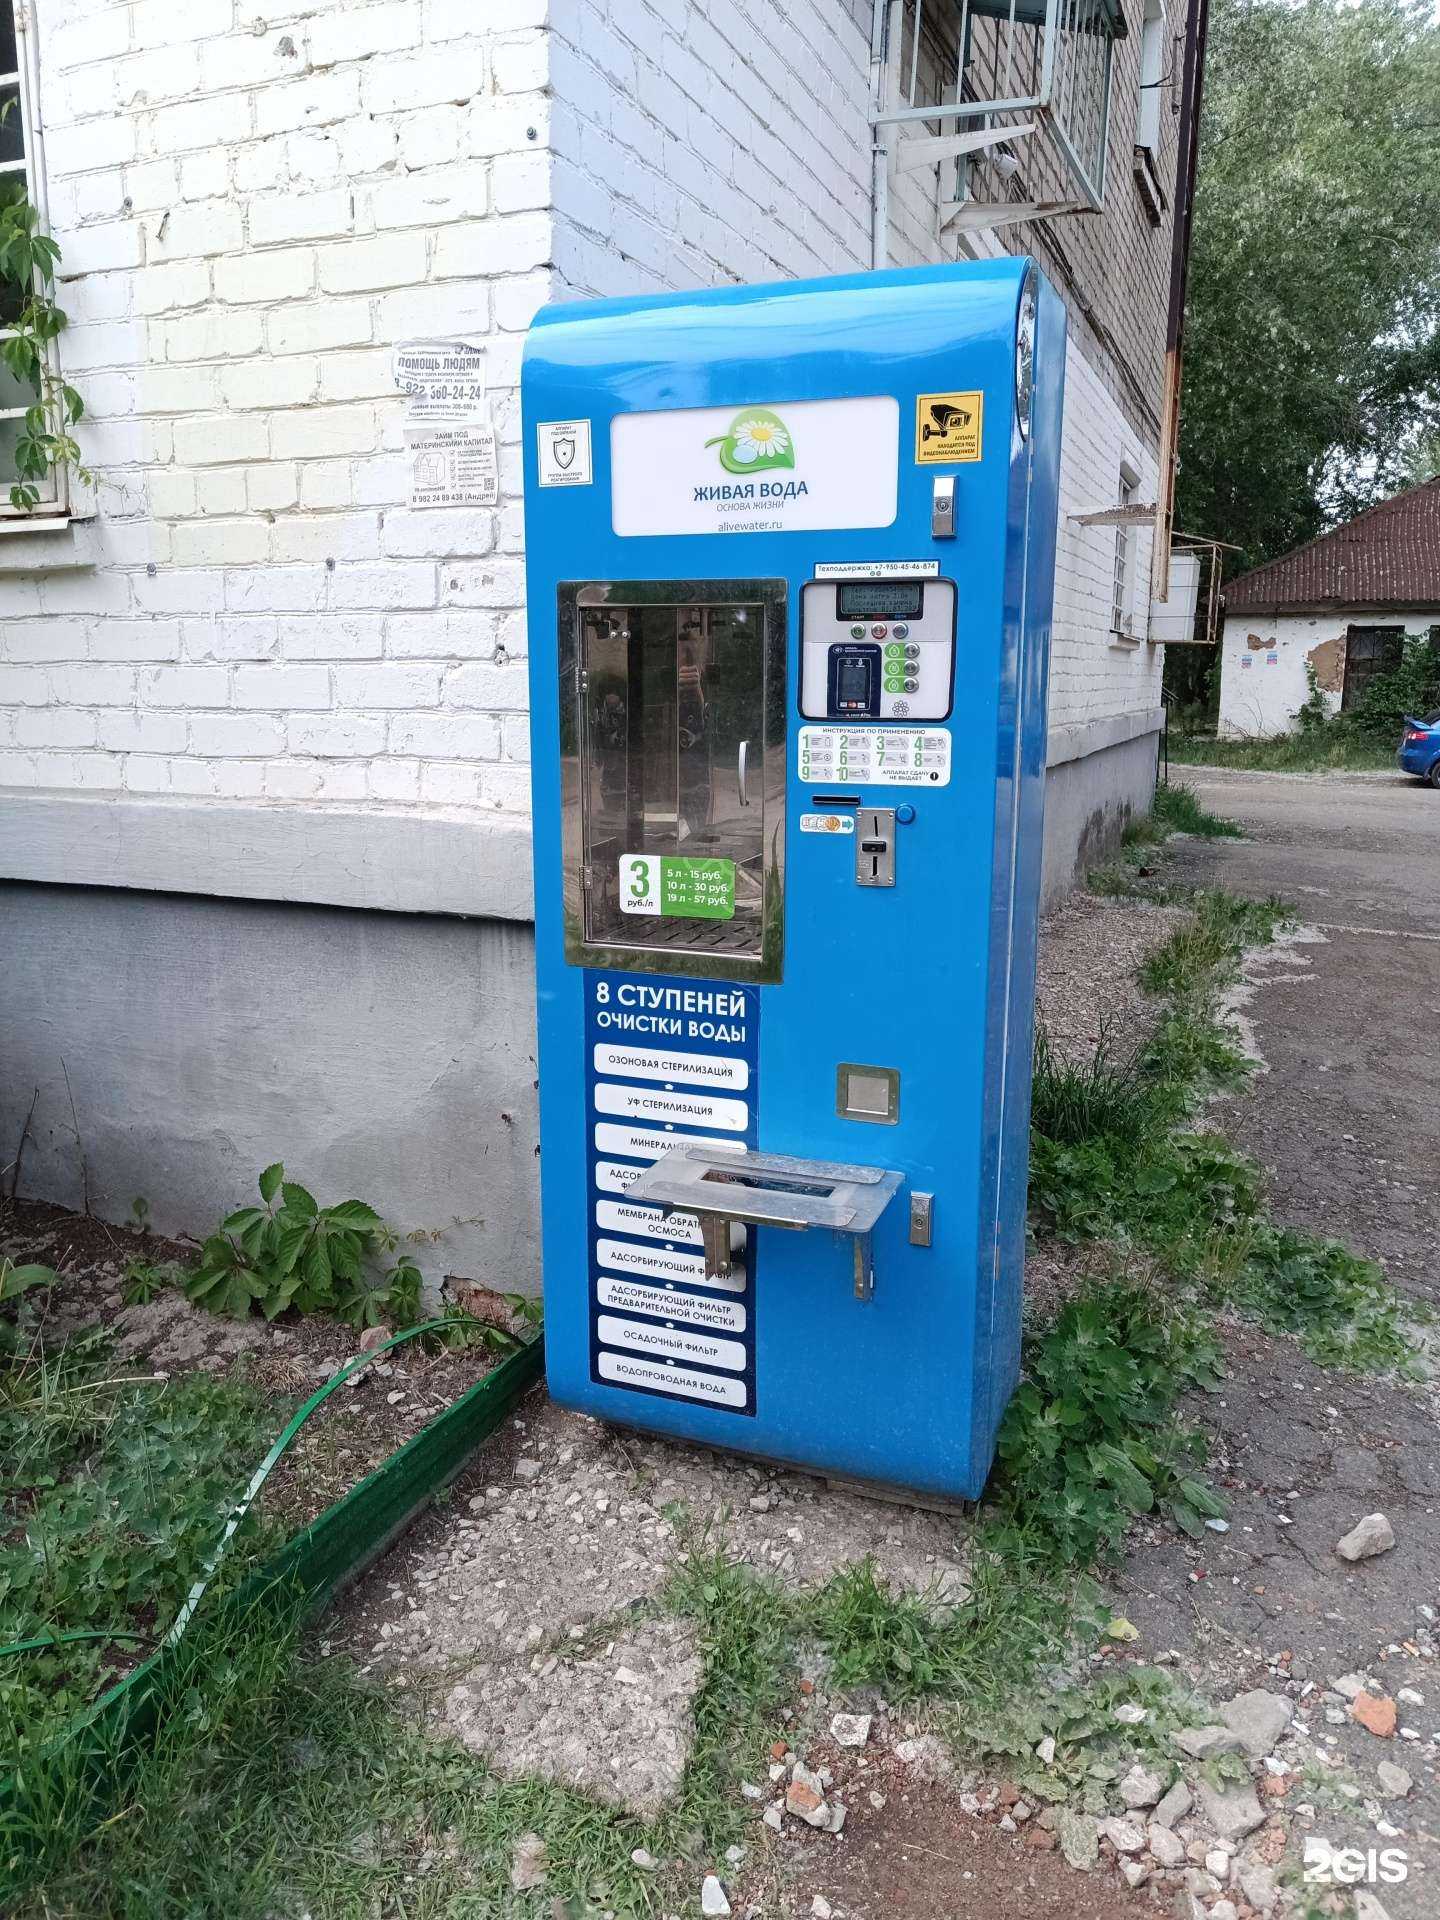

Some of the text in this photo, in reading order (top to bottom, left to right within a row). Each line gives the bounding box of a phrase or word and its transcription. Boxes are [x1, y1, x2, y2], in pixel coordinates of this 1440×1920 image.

[398, 357, 480, 371] ПОМОЩЬ ЛЮДЯМ
[463, 438, 493, 446] КАПИТАЛ
[693, 481, 808, 501] ЖИВАЯ ВОДА
[716, 500, 784, 512] ОСНОВА ЖИЗНИ
[718, 520, 783, 532] alivewater.ru
[818, 565, 872, 573] Техподдержка:
[802, 734, 809, 749] 1
[839, 735, 848, 749] 2
[876, 735, 885, 750] 3
[914, 736, 923, 751] 4
[802, 750, 810, 764] 5
[839, 751, 848, 765] 6
[876, 752, 885, 766] 7
[914, 753, 923, 767] 8
[801, 766, 810, 780] 9
[836, 767, 848, 781] 10
[630, 860, 650, 898] 3
[667, 869, 674, 877] 5
[690, 870, 700, 879] 15
[701, 870, 723, 882] руб.
[667, 881, 677, 890] 10
[694, 882, 707, 891] 30
[708, 883, 730, 894] руб.
[627, 898, 653, 907] руб./л
[667, 893, 677, 902] 19
[694, 894, 705, 903] 57
[707, 895, 728, 906] руб.
[596, 981, 746, 1018] 8 СТУПЕНЕЙ
[597, 1011, 746, 1043] ОЧИСТКИ ВОДЫ
[608, 1055, 733, 1078] ОЗОНОВАЯ СТЕРИЛИЗАЦИЯ
[627, 1097, 713, 1116] УФ СТЕРИЛИЗАЦИЯ
[609, 1169, 643, 1180] АДСОР
[617, 1208, 667, 1224] МЕМБРАНА
[647, 1224, 692, 1239] ОСМОСА
[611, 1252, 732, 1280] АДСОРБИРУЮЩИЙ ФЬТР
[611, 1285, 732, 1314] АДСОРБИРУЮЩИЙ ФИЛЬТР
[607, 1295, 736, 1327] ПРЕДВАРИТЕЛЬНОЙ ОЧИСТКИ
[623, 1330, 719, 1357] ОСАДОЧНЫЙ ФИЛЬТР
[616, 1364, 727, 1394] ВОДОПРОВОДНАЯ ВОДА
